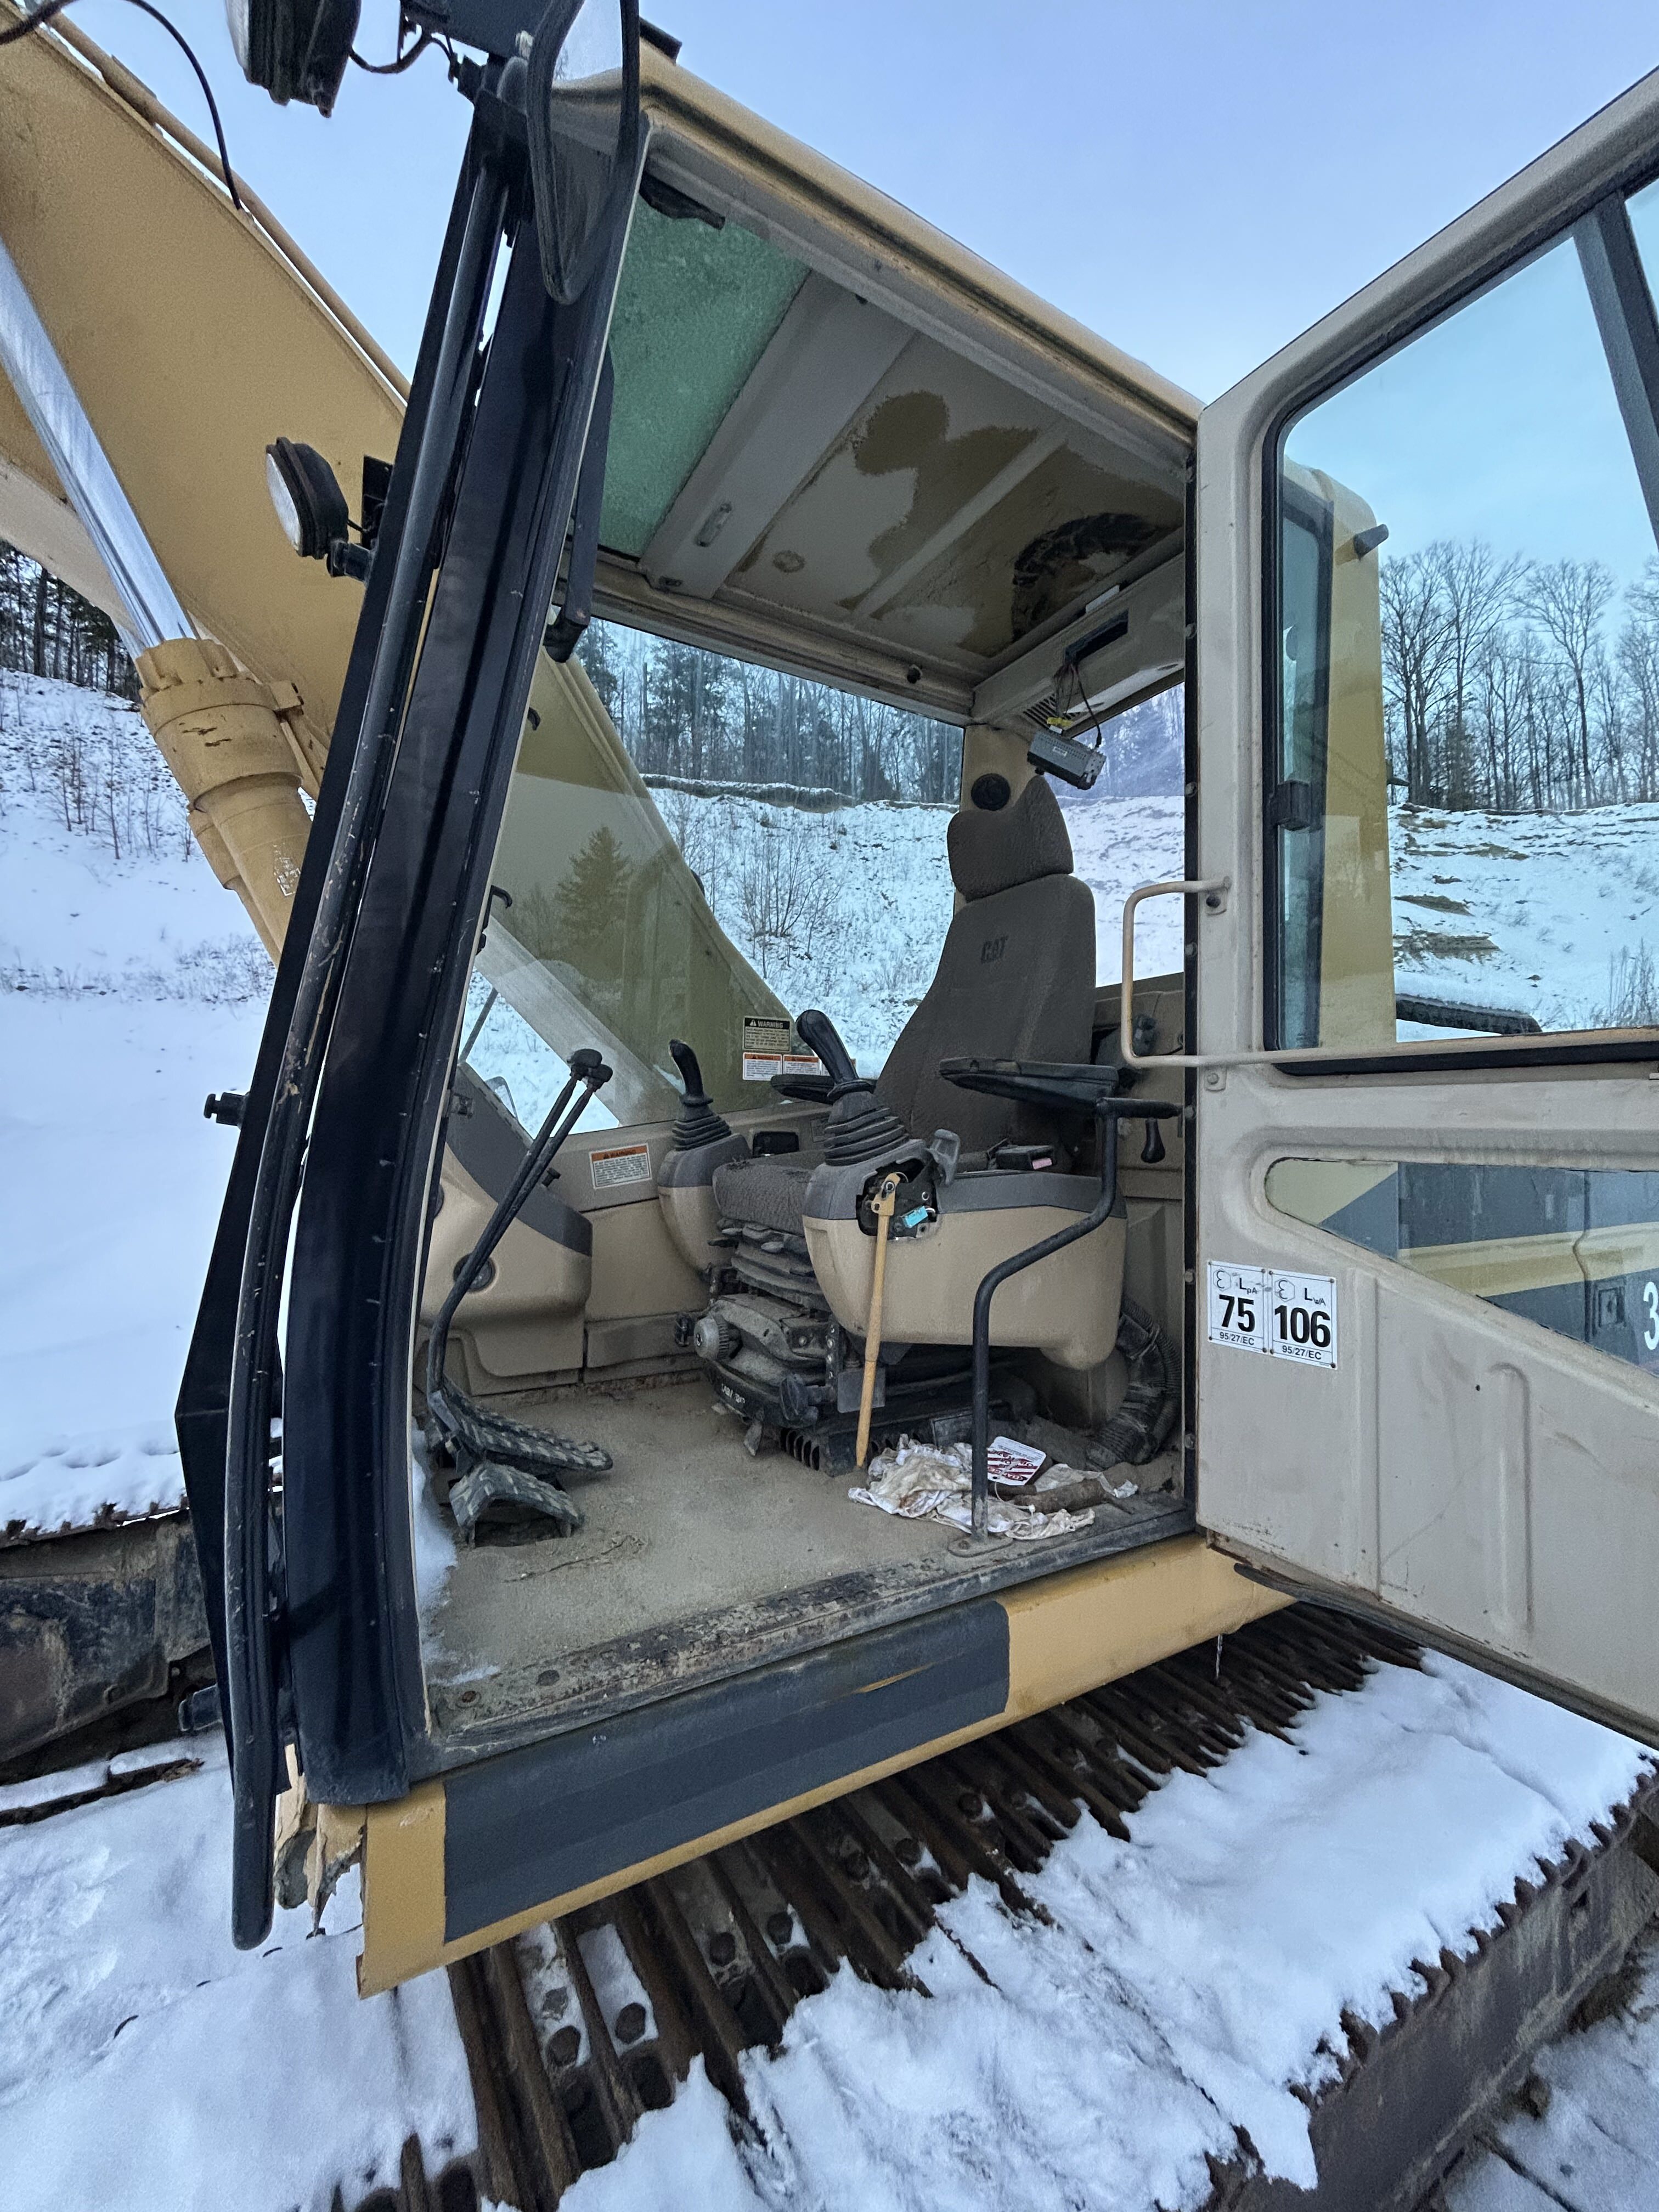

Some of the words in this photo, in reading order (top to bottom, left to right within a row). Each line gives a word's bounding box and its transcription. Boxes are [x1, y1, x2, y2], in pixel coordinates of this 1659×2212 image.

[981, 935, 1009, 964] CAT
[758, 1020, 783, 1029] WARNING
[1218, 1294, 1256, 1333] 75
[1274, 1305, 1331, 1347] 106
[1220, 1331, 1255, 1345] 95/27/EC
[1282, 1345, 1322, 1360] 95/27/EC
